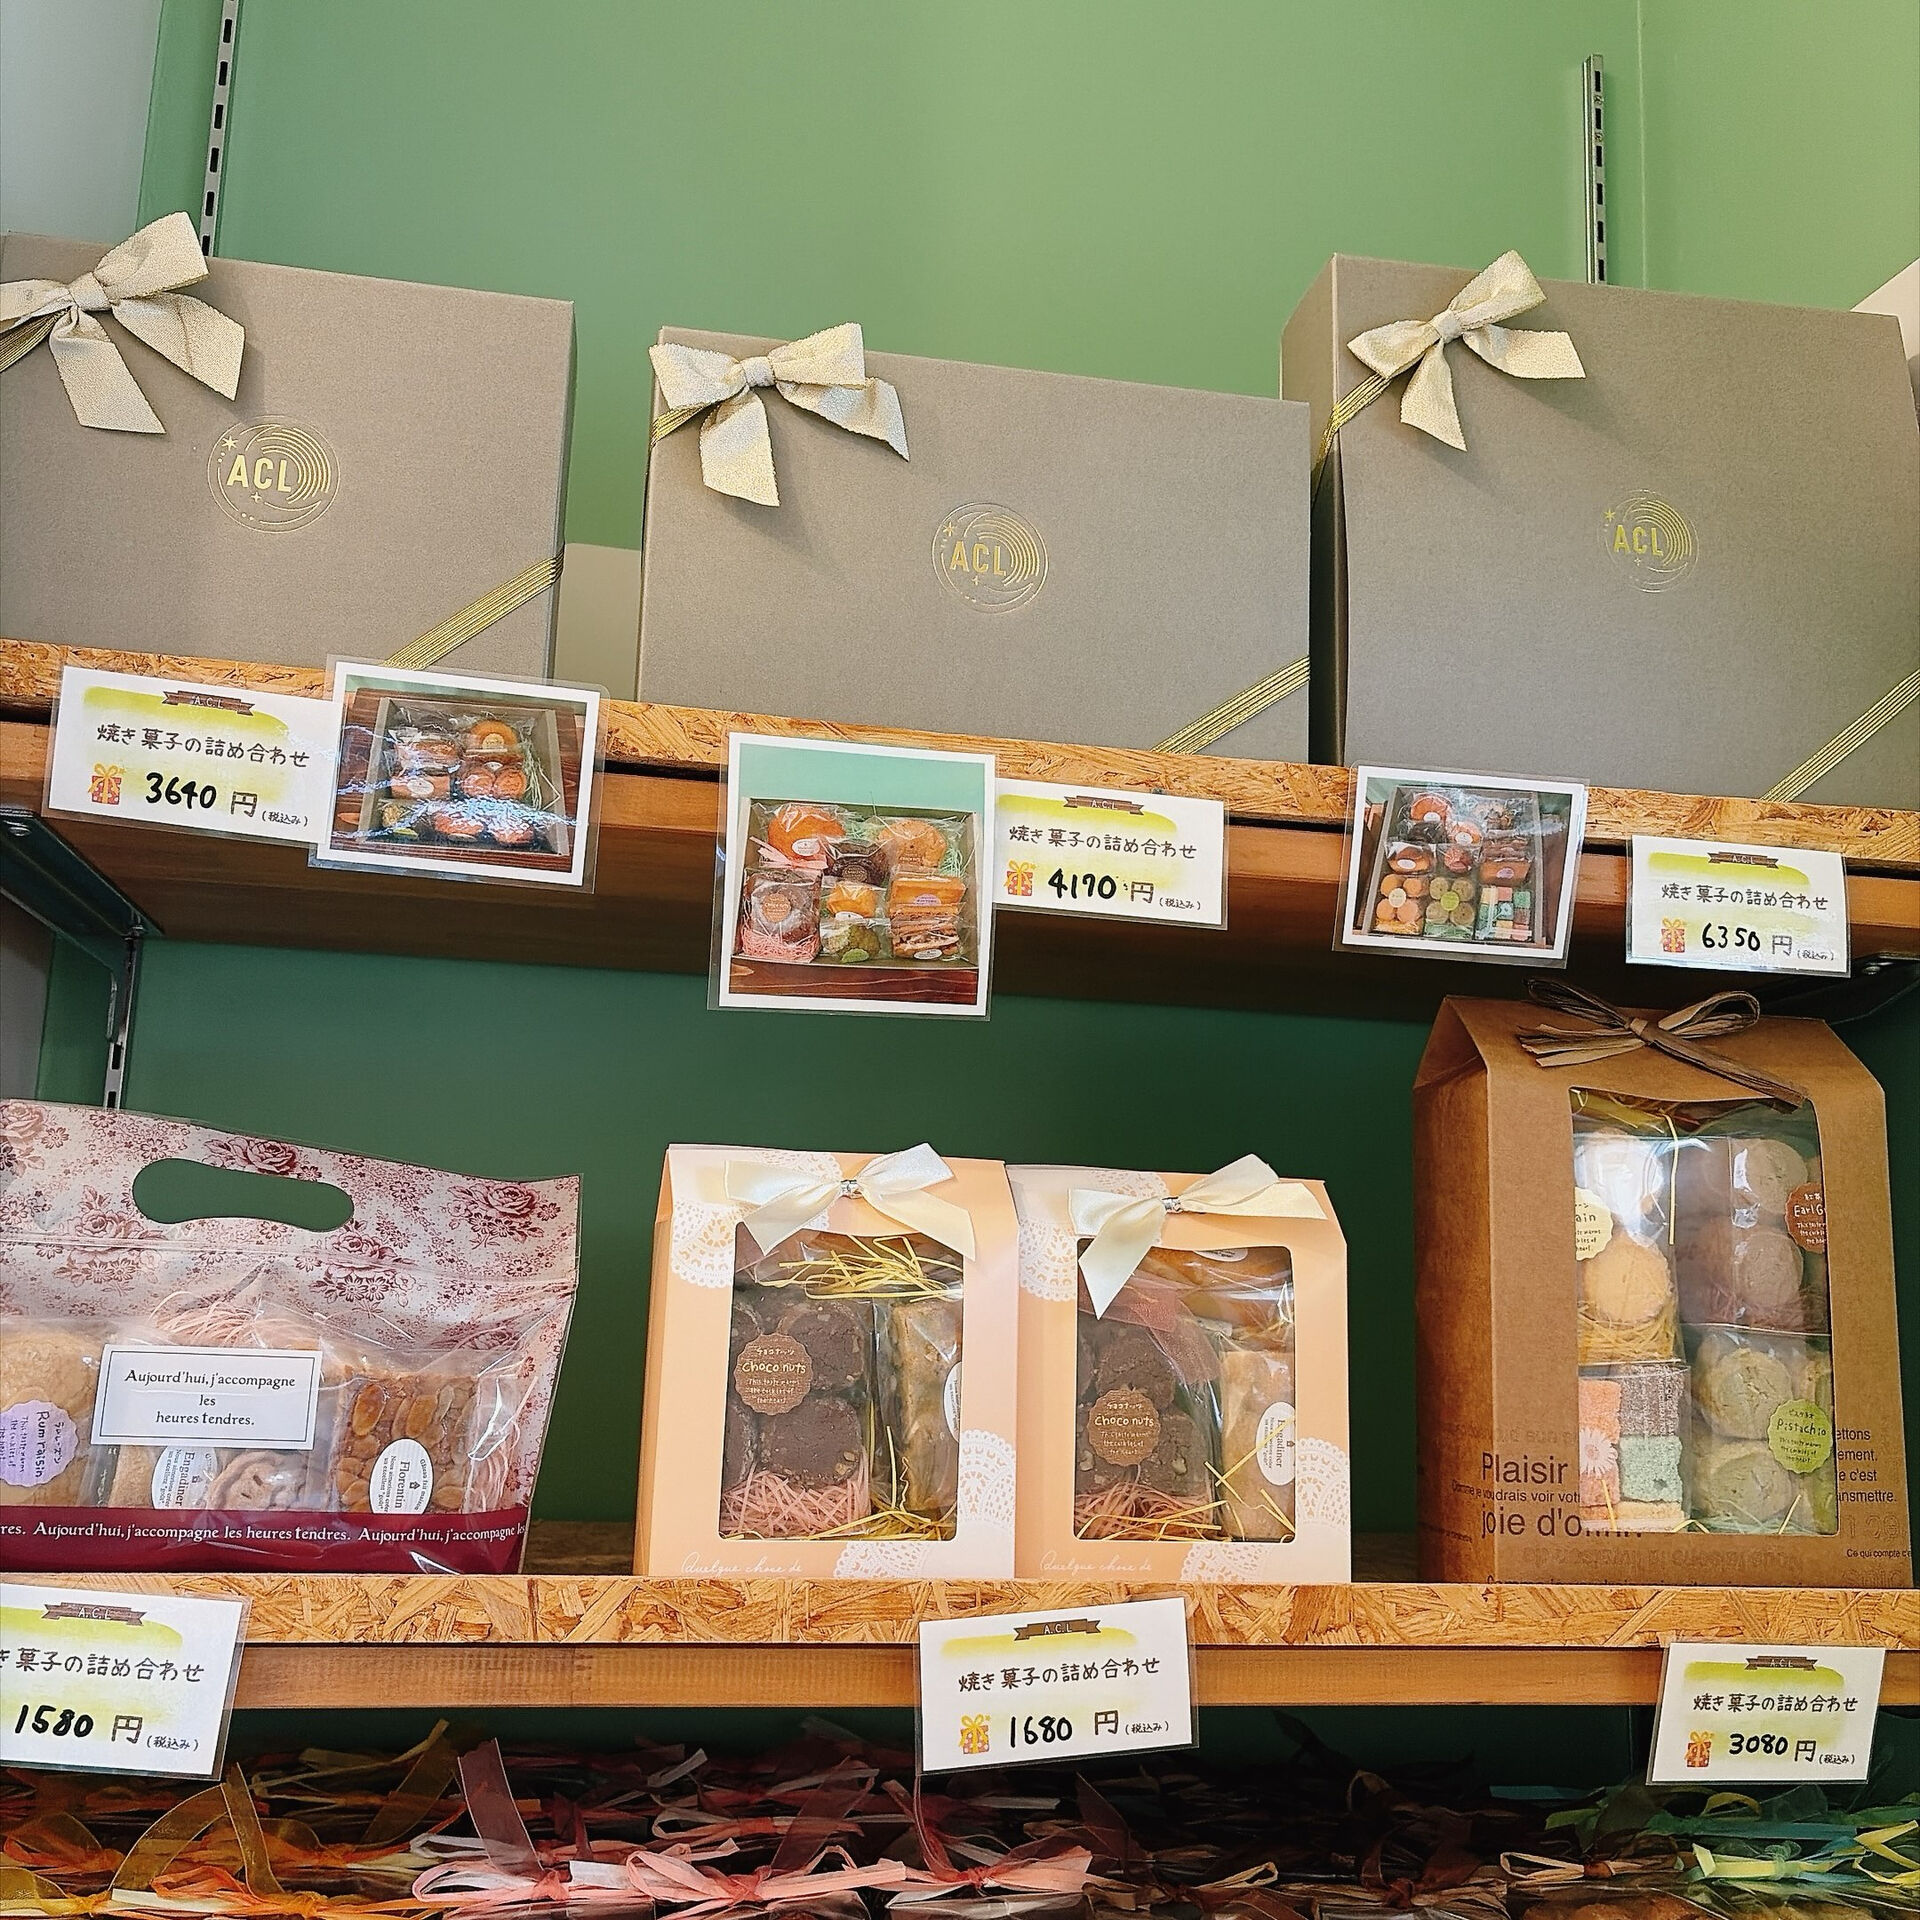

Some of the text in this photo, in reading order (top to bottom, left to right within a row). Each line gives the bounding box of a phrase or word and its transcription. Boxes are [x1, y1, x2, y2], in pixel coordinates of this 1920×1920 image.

[227, 455, 292, 493] ACL
[1614, 525, 1663, 556] ACL
[950, 540, 1007, 576] ACL
[97, 723, 310, 768] 焼き菓子の詰め合わせ
[145, 772, 217, 810] 3640
[230, 791, 258, 818] 円
[1009, 825, 1198, 860] 焼き菓子の詰め合わせ
[1048, 868, 1117, 900] 4170
[1130, 881, 1155, 904] 円
[1661, 883, 1830, 911] 焼き菓子の詰め合わせ
[1701, 922, 1761, 951] 6350
[1772, 934, 1792, 957] 円
[1793, 1204, 1815, 1217] Earl
[125, 1369, 296, 1390] Aujourd'hui, j'accompagne
[742, 1361, 806, 1374] Choco nuts
[199, 1394, 216, 1406] les
[156, 1411, 255, 1426] heures tendres.
[1095, 1416, 1154, 1427] Choco nuts
[1777, 1418, 1826, 1436] Pistachio
[35, 1411, 50, 1478] Rum raisin
[1276, 1420, 1285, 1468] Egadiner
[1836, 1428, 1871, 1441] ettons
[1482, 1452, 1569, 1484] Plaisir
[1838, 1450, 1878, 1462] ement.
[175, 1452, 196, 1506] Engadiner
[394, 1461, 411, 1508] Florentin
[1850, 1469, 1877, 1482] c'est
[1531, 1490, 1553, 1502] voir
[0, 1524, 26, 1535] res.
[33, 1522, 125, 1540] Aujourd'hui,
[126, 1523, 219, 1542] j'accompagne
[224, 1526, 242, 1539] les
[246, 1526, 292, 1540] heures
[295, 1526, 351, 1540] tendres.
[358, 1527, 444, 1544] Aujourd'hui,
[444, 1526, 515, 1544] j'accompagne
[1481, 1504, 1526, 1539] joie
[958, 1657, 1161, 1692] 焼き菓子の詰め合わせ
[1692, 1693, 1859, 1713] 焼き菓子の詰め合わせ
[14, 1704, 199, 1751] 1580 円 (税込み)
[1009, 1710, 1169, 1749] 1680 円 (税込み)
[1728, 1733, 1788, 1755] 3080
[1794, 1740, 1816, 1762] 円
